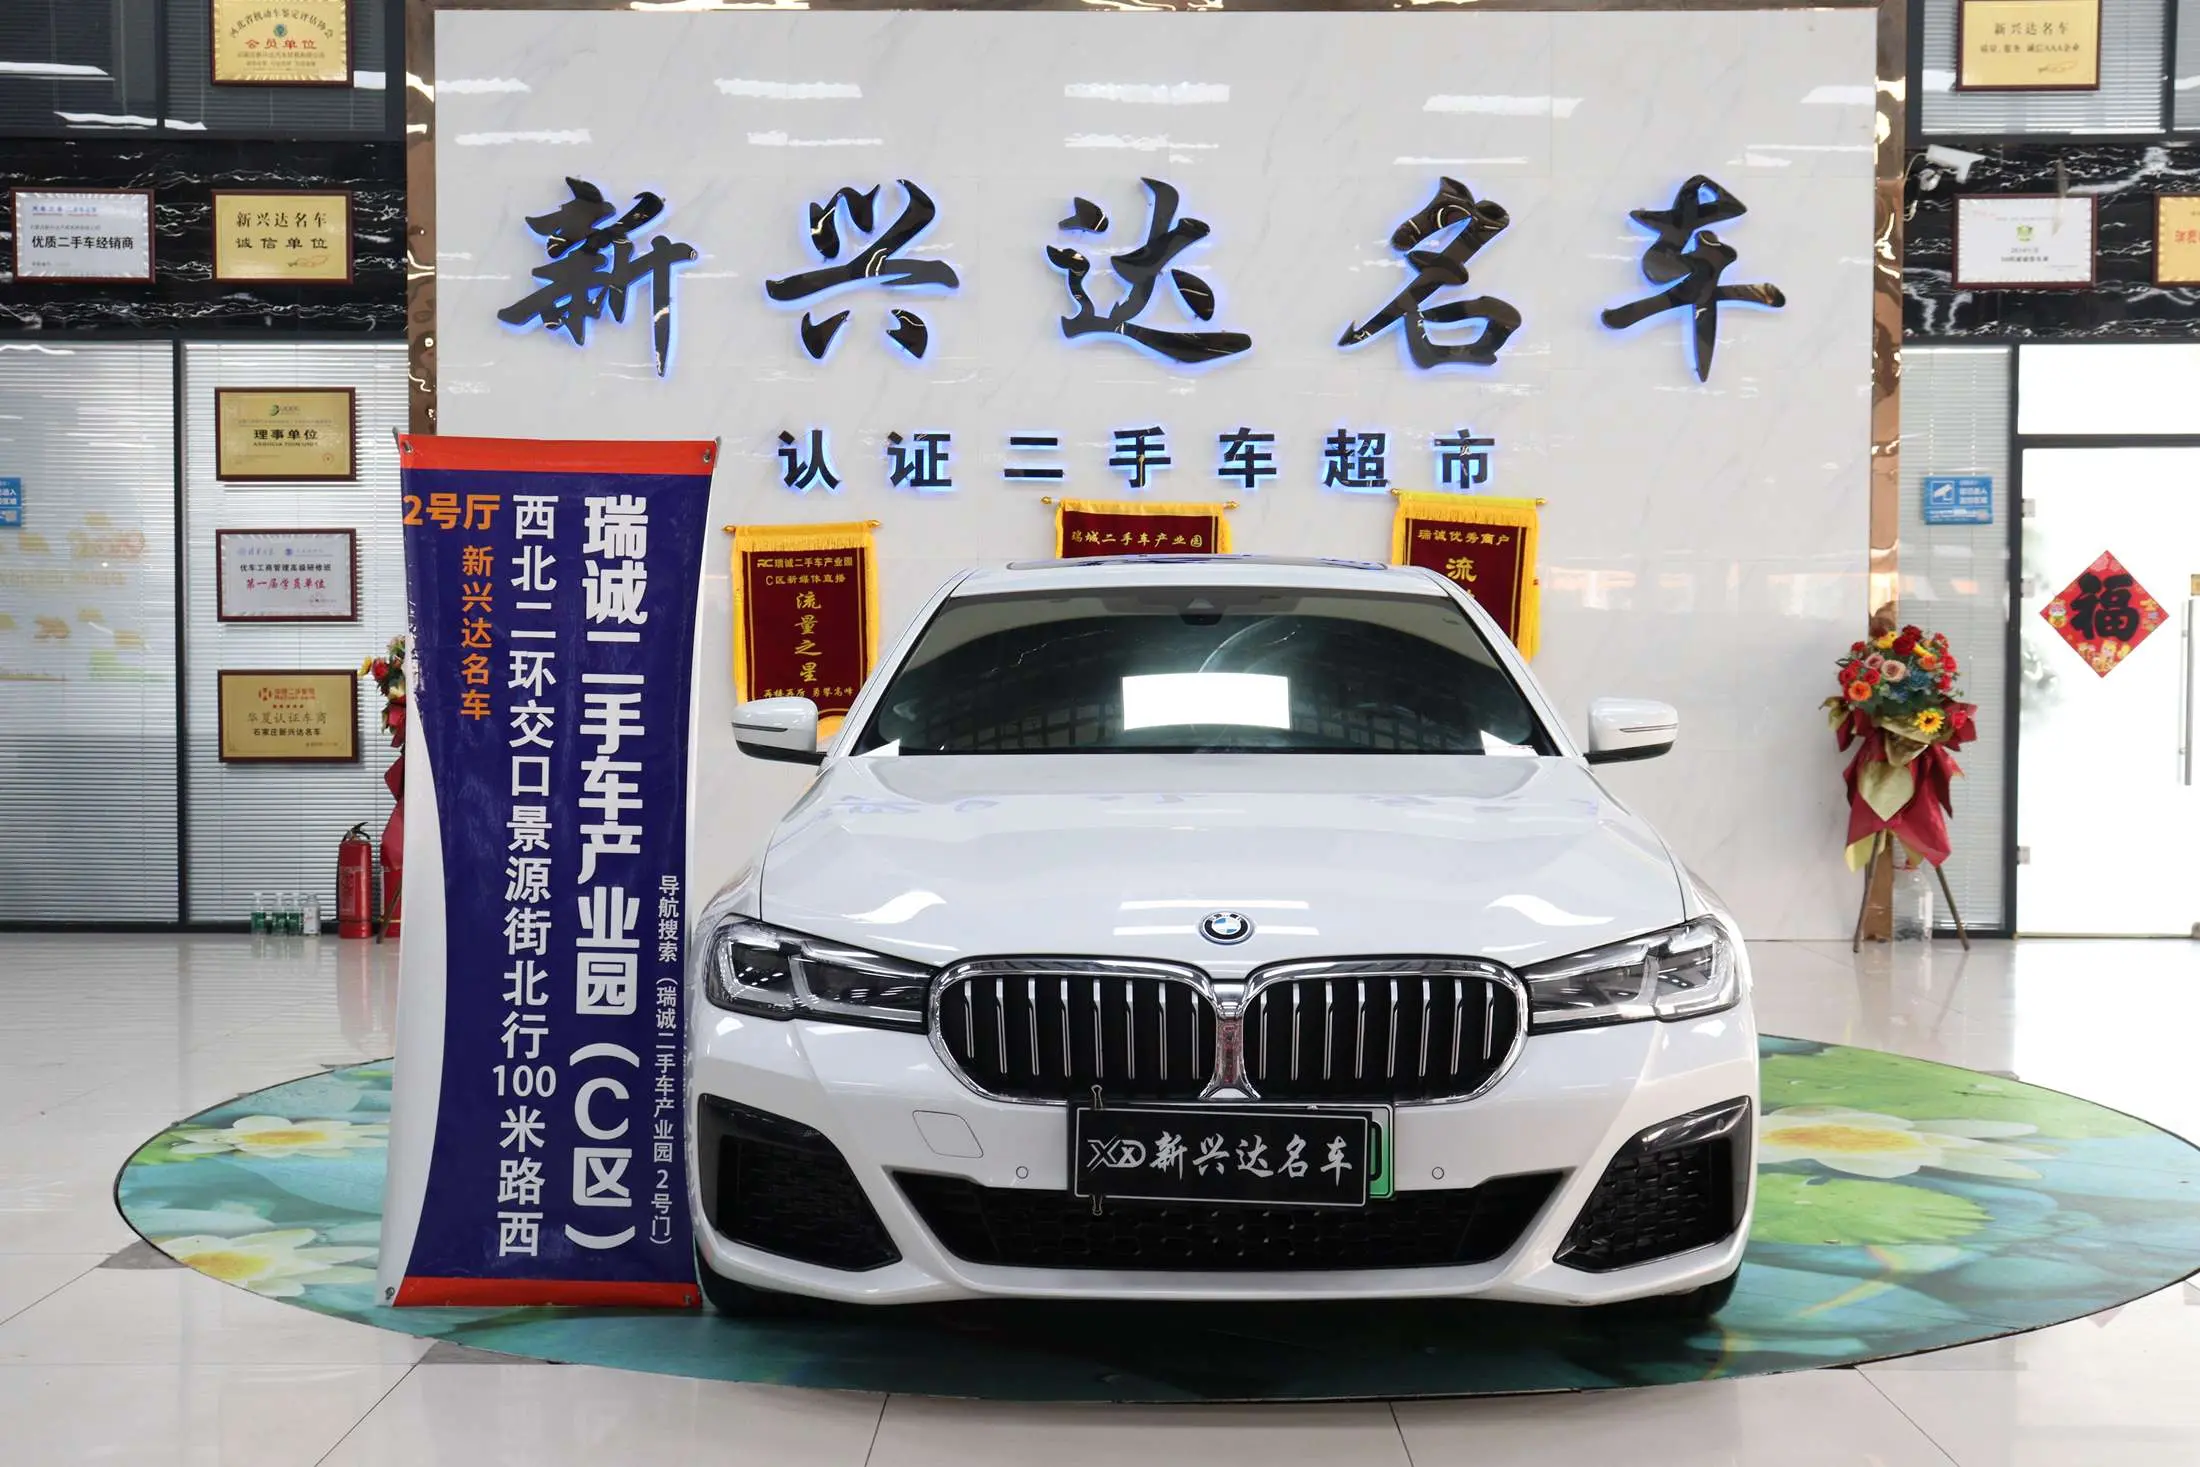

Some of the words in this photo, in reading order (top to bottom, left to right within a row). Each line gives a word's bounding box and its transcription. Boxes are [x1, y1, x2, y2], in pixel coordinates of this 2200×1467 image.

[245, 38, 317, 49] 会员单位
[236, 211, 327, 228] 新兴达名车
[31, 235, 134, 250] 优质二手车经销商
[235, 237, 329, 249] 诚信单位
[497, 174, 1786, 382] 新兴达名车
[253, 429, 318, 440] 理事单位
[778, 426, 1496, 490] 认证二手车超市
[402, 492, 501, 531] 2号厅
[246, 578, 326, 592] 第一届学员单位
[1445, 556, 1478, 598] 流
[2070, 572, 2141, 642] 福
[459, 544, 495, 721] 新兴达名车
[794, 590, 823, 683] 流量之星
[253, 727, 322, 737] 石家庄新兴达名车
[1149, 1130, 1353, 1187] 新兴达名车
